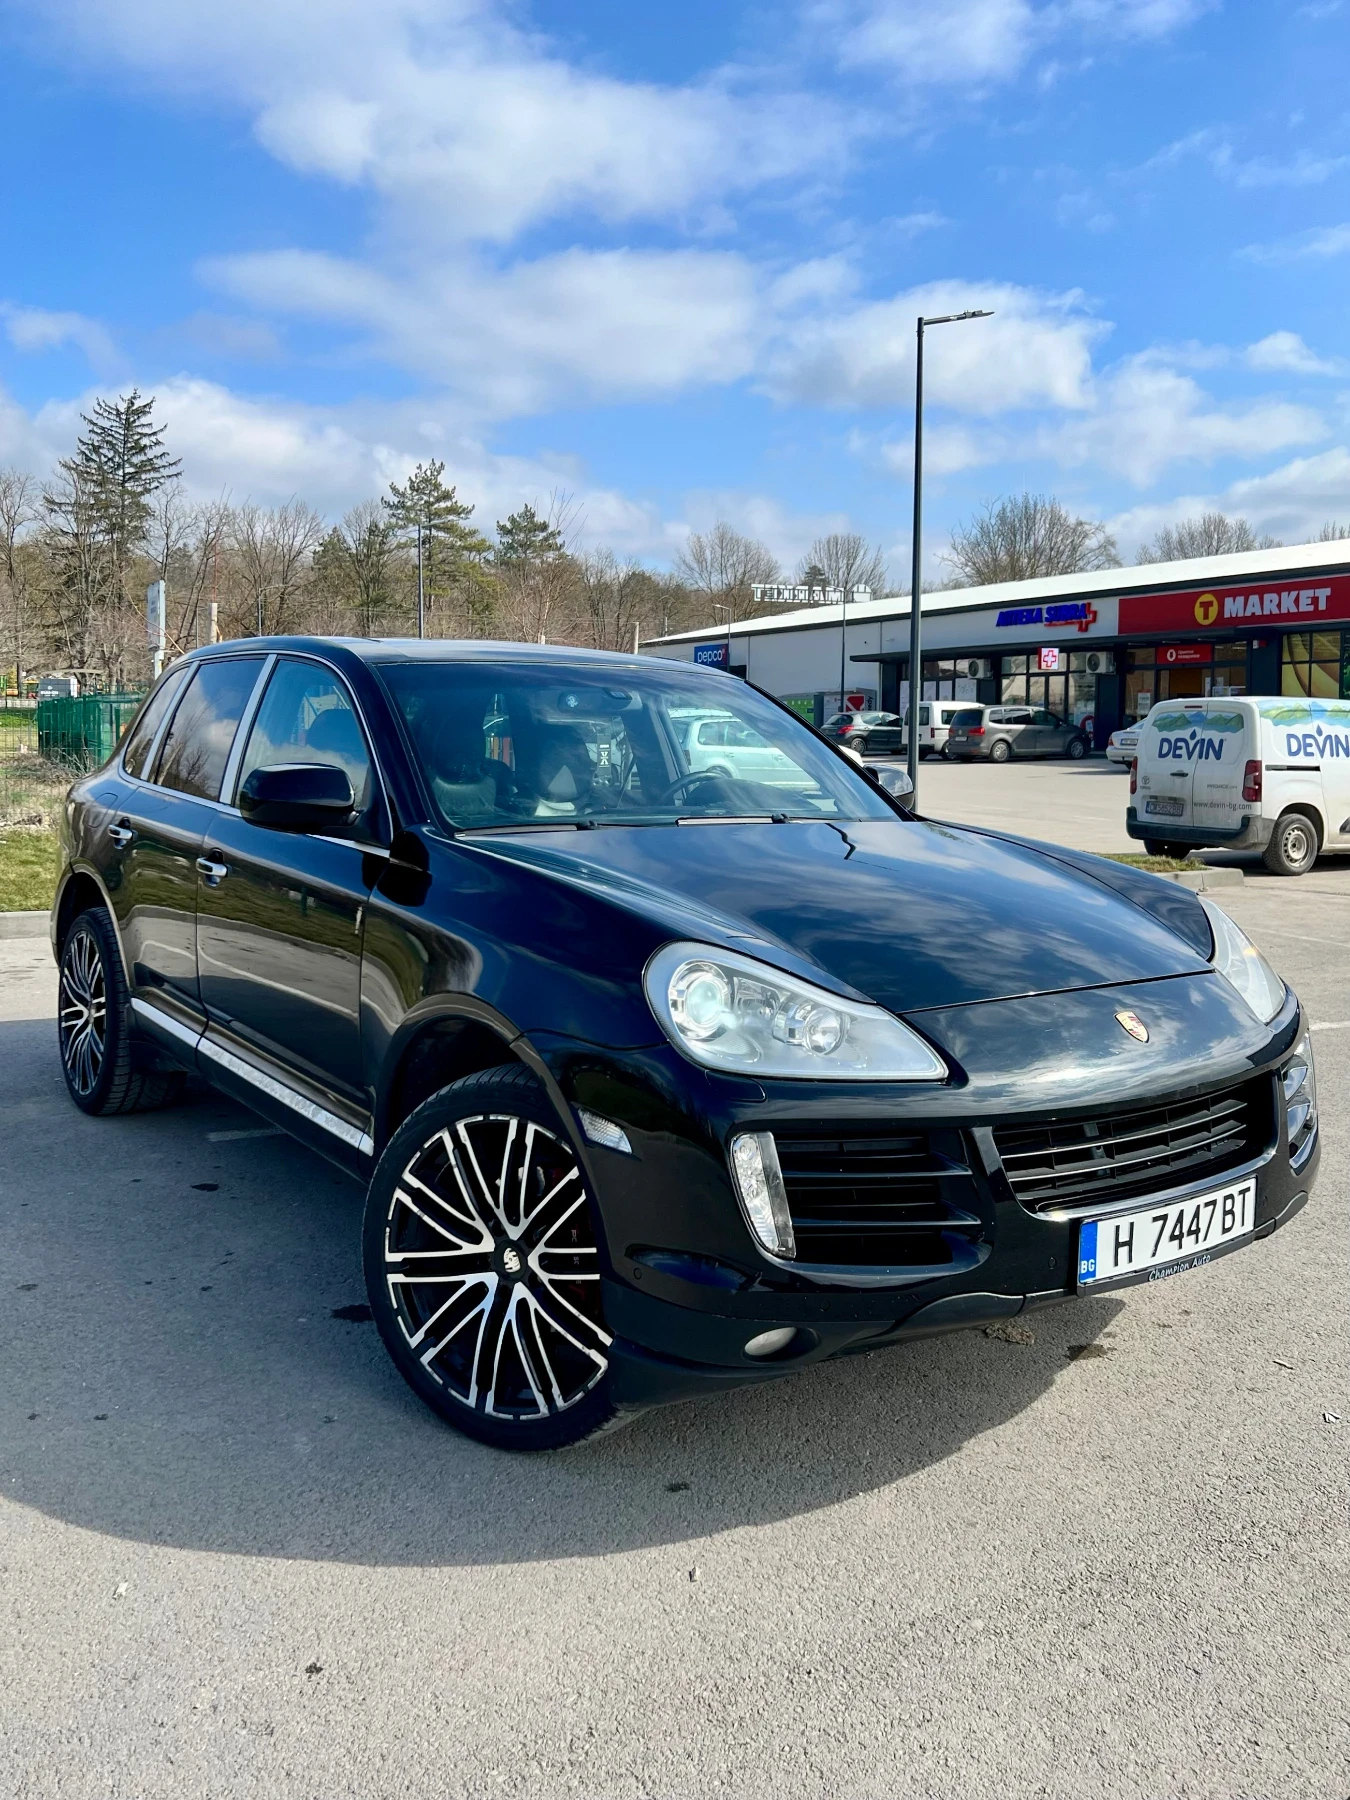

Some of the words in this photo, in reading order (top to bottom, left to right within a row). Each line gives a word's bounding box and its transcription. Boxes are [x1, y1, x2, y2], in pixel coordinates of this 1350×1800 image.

[1223, 587, 1332, 619] MARKET
[697, 650, 723, 664] pepco
[1158, 737, 1224, 760] DEVIN
[1286, 733, 1350, 758] DEVIN
[1193, 801, 1252, 812] www.devin-bg.com
[1113, 1221, 1135, 1268] H
[1080, 1258, 1096, 1274] BG
[1148, 1261, 1190, 1282] Champion
[1192, 1254, 1211, 1268] Auto
